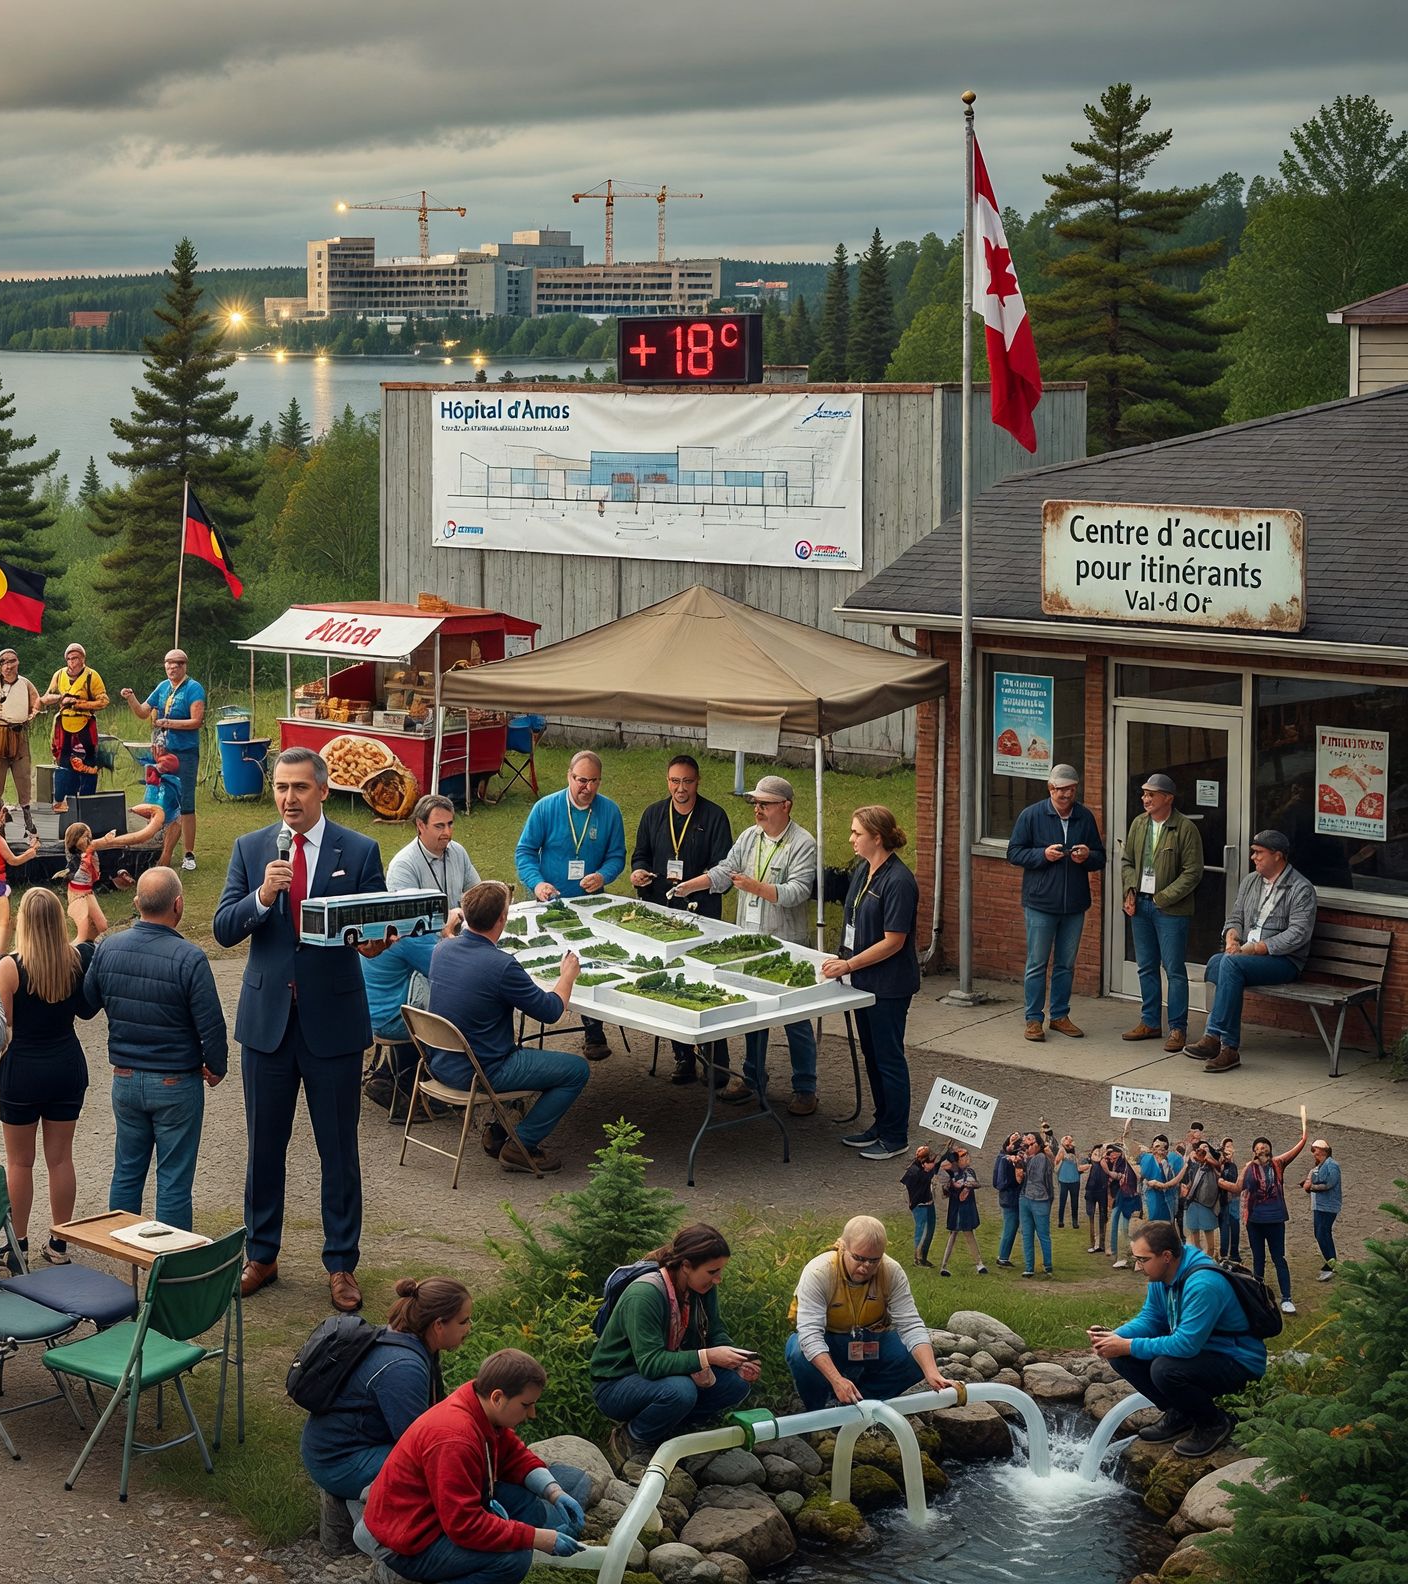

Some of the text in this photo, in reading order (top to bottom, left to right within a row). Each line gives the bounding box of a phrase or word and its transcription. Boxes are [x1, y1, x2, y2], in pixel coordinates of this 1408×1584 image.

[440, 398, 503, 424] Hôpital
[1069, 515, 1272, 552] Centre d'accueil
[1076, 554, 1263, 589] pour itinérants
